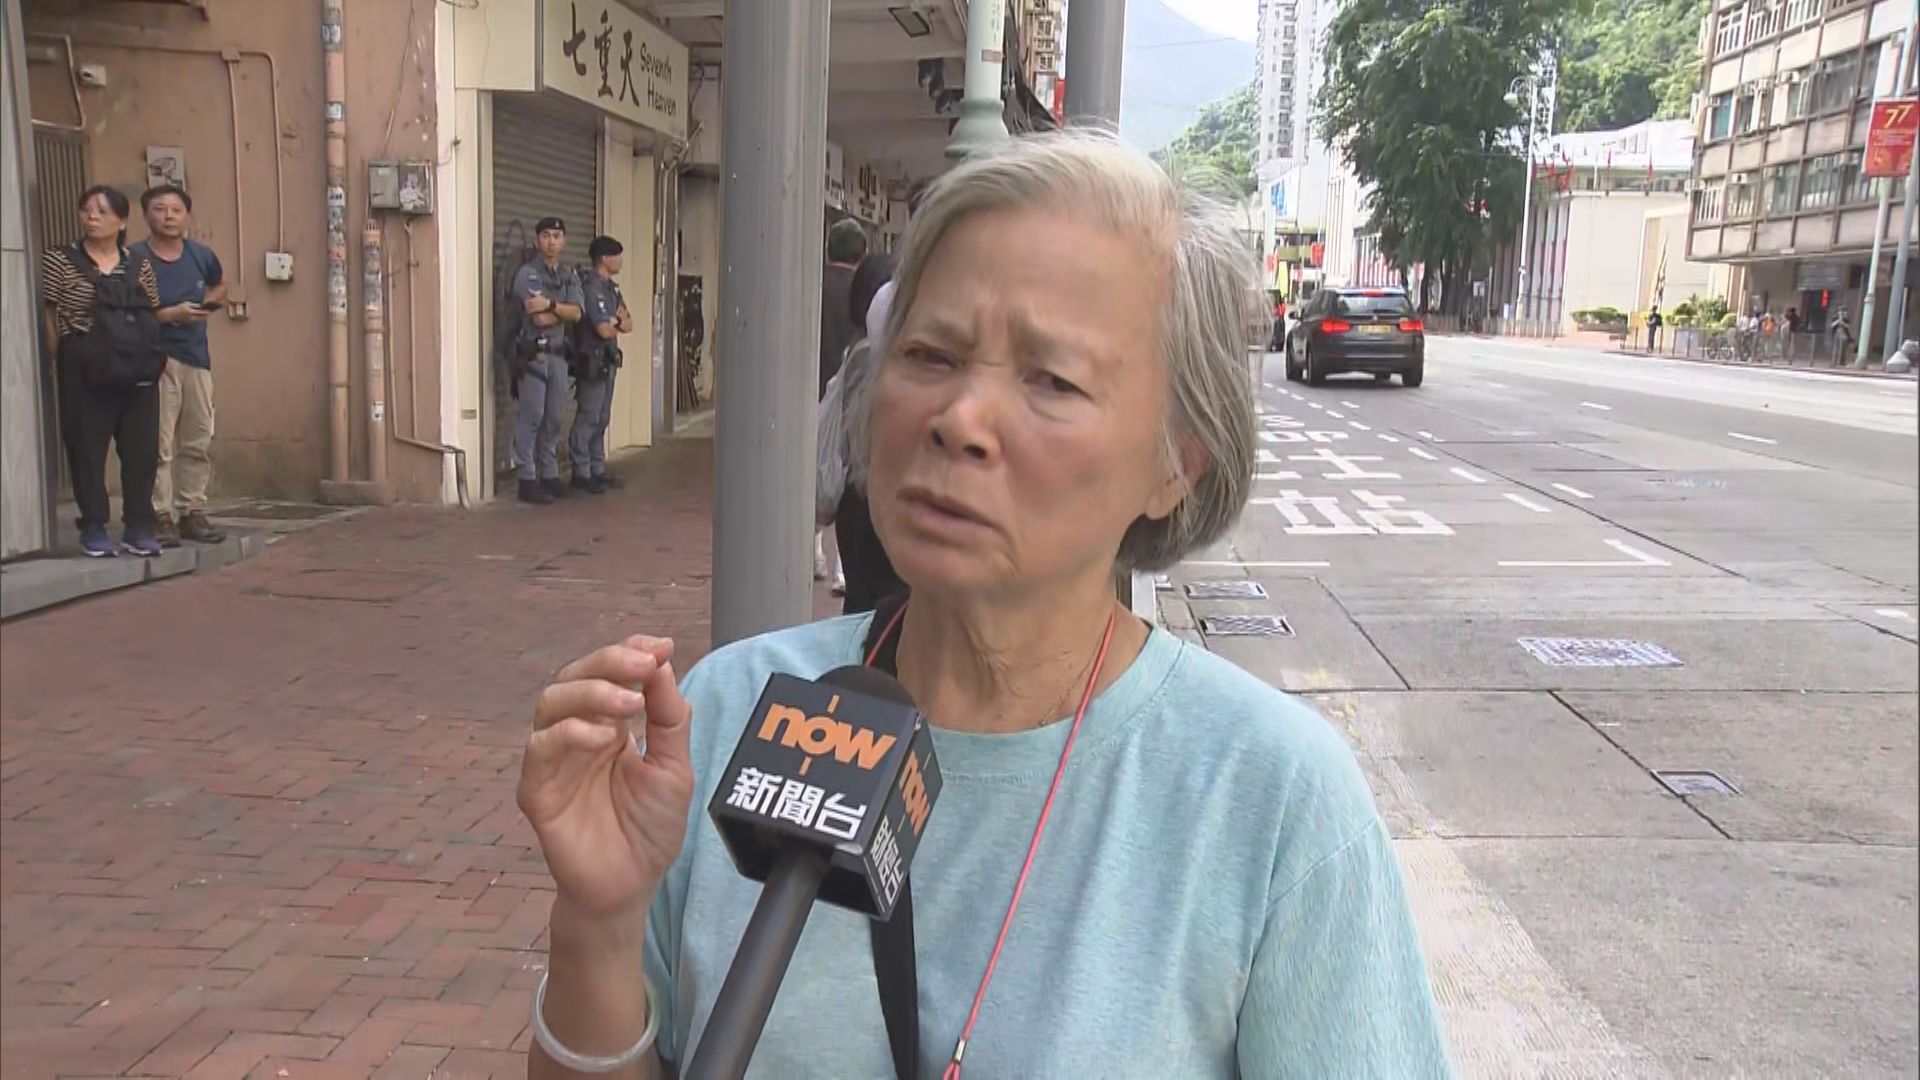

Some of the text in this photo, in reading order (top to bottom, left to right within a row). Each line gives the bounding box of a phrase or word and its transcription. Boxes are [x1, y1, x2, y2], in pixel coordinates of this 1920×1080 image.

[563, 1, 640, 108] 七重天
[640, 42, 672, 84] Seventh
[647, 78, 677, 118] Heaven
[1883, 104, 1914, 128] 77
[1249, 489, 1456, 535] 站
[757, 701, 896, 770] now
[726, 766, 868, 841] 新聞台
[899, 750, 931, 837] now
